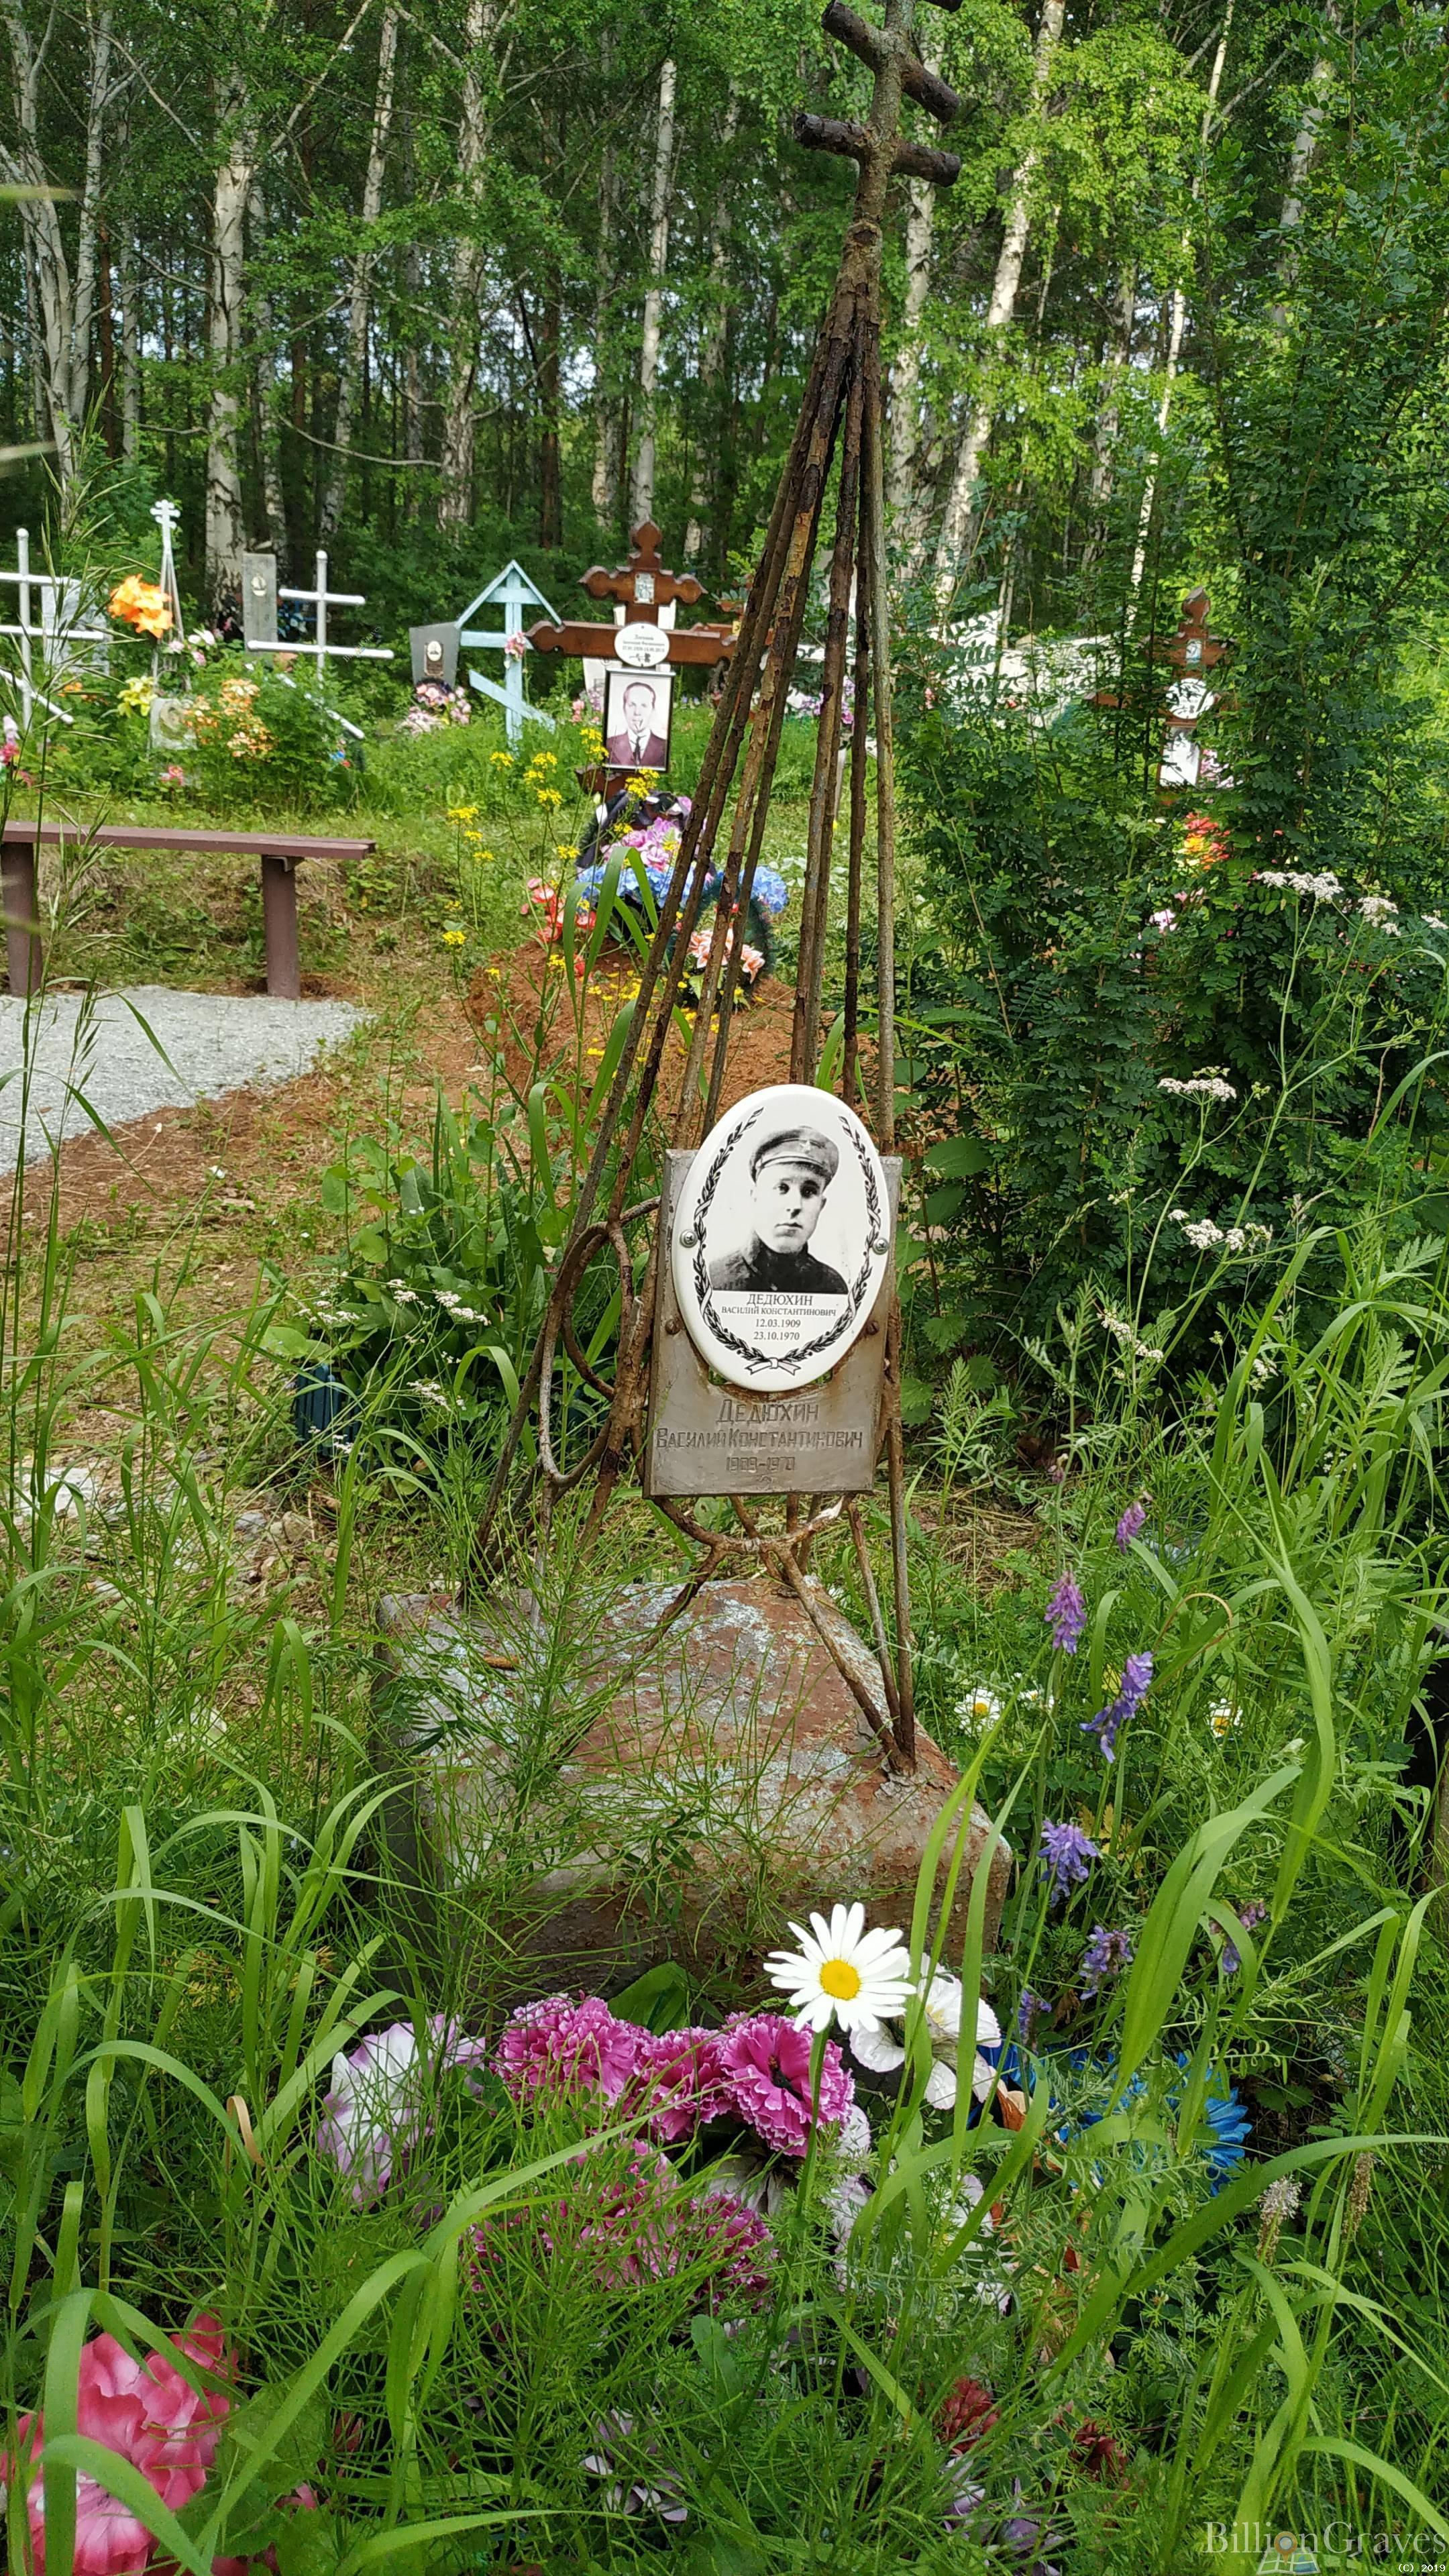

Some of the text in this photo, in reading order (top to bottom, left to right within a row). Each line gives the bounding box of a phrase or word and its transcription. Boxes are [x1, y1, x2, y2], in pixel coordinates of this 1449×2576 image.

[746, 1293, 813, 1307] ДЕДЮХИН
[721, 1306, 837, 1316] ВАСИЛИЙ КОНСТАНТИНОВИЧ
[755, 1318, 801, 1328] 12.03.1909
[753, 1331, 800, 1340] 23.10.1970
